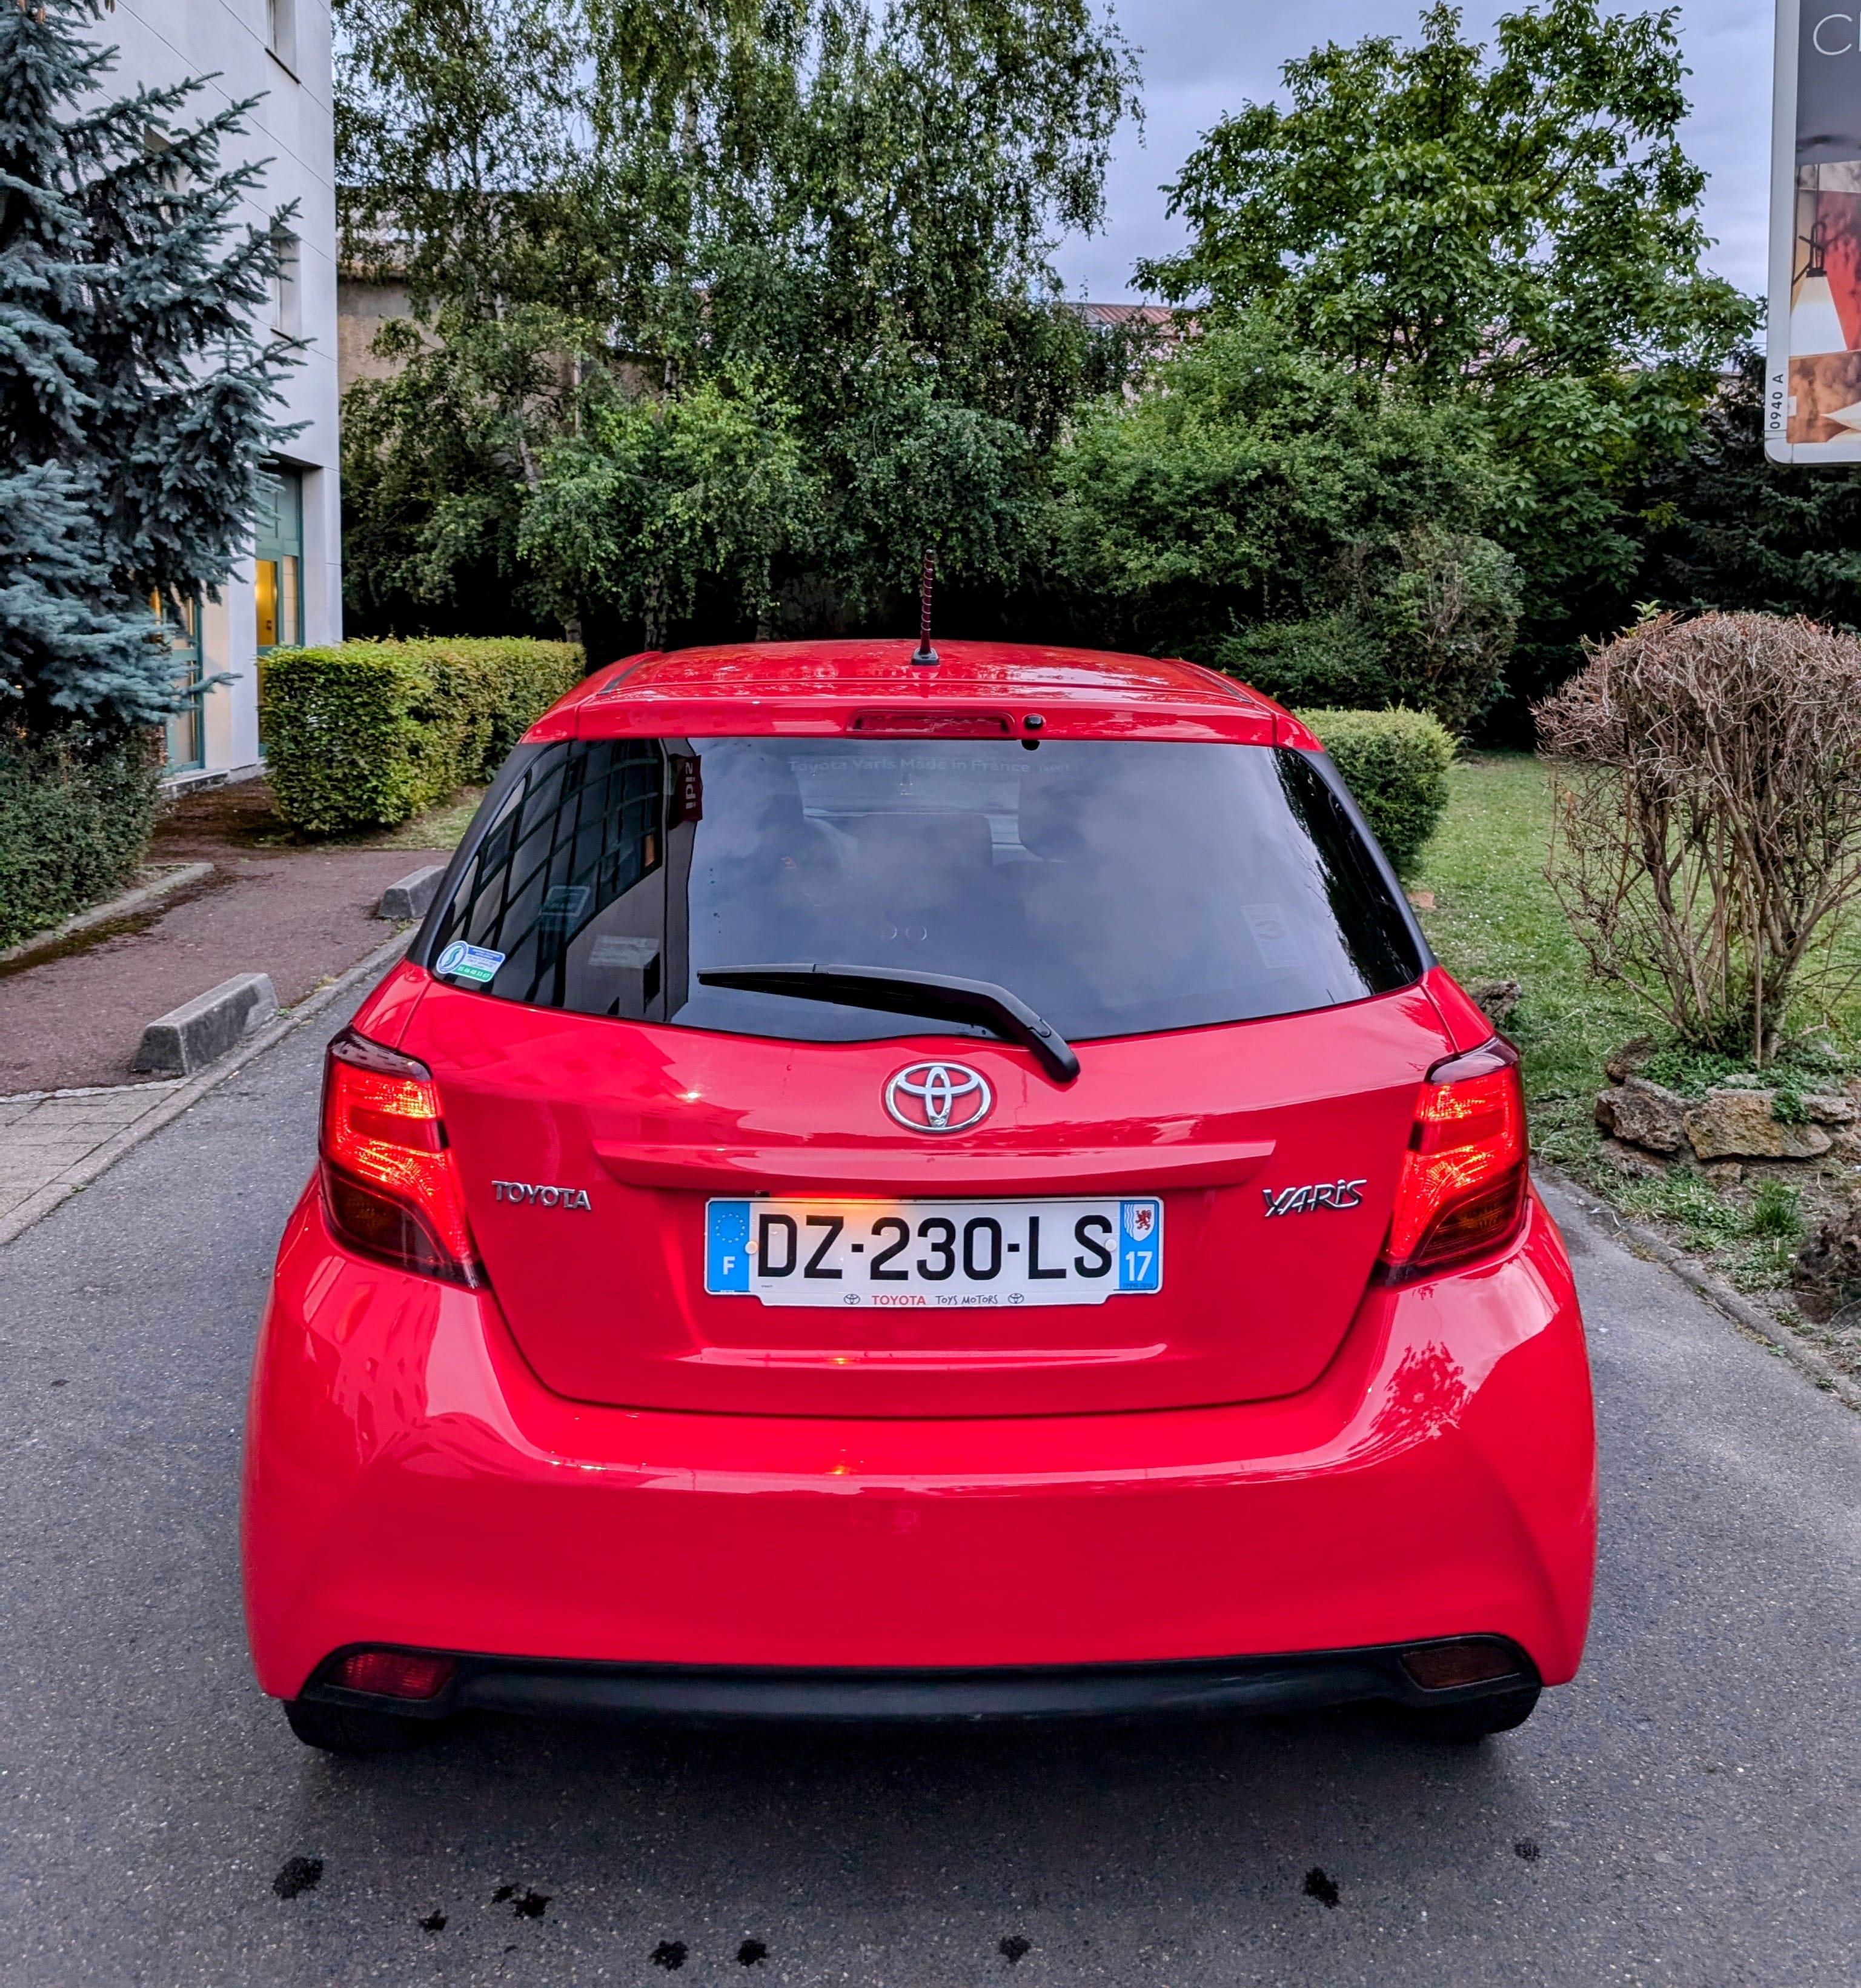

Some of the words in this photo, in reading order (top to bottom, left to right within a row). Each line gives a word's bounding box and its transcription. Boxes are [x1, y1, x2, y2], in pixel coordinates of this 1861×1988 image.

[1813, 12, 1861, 55] C
[1772, 374, 1783, 384] A
[1770, 391, 1783, 429] 0940
[788, 760, 847, 773] Toyota
[852, 759, 897, 770] Yaris
[900, 759, 947, 770] Made
[952, 759, 966, 770] in
[972, 759, 1030, 772] France
[491, 1180, 592, 1211] TOYOTA
[757, 1214, 1113, 1280] DZ-230-LS
[723, 1256, 735, 1275] F
[1125, 1251, 1153, 1281] 17
[871, 1295, 926, 1305] TOYOTA
